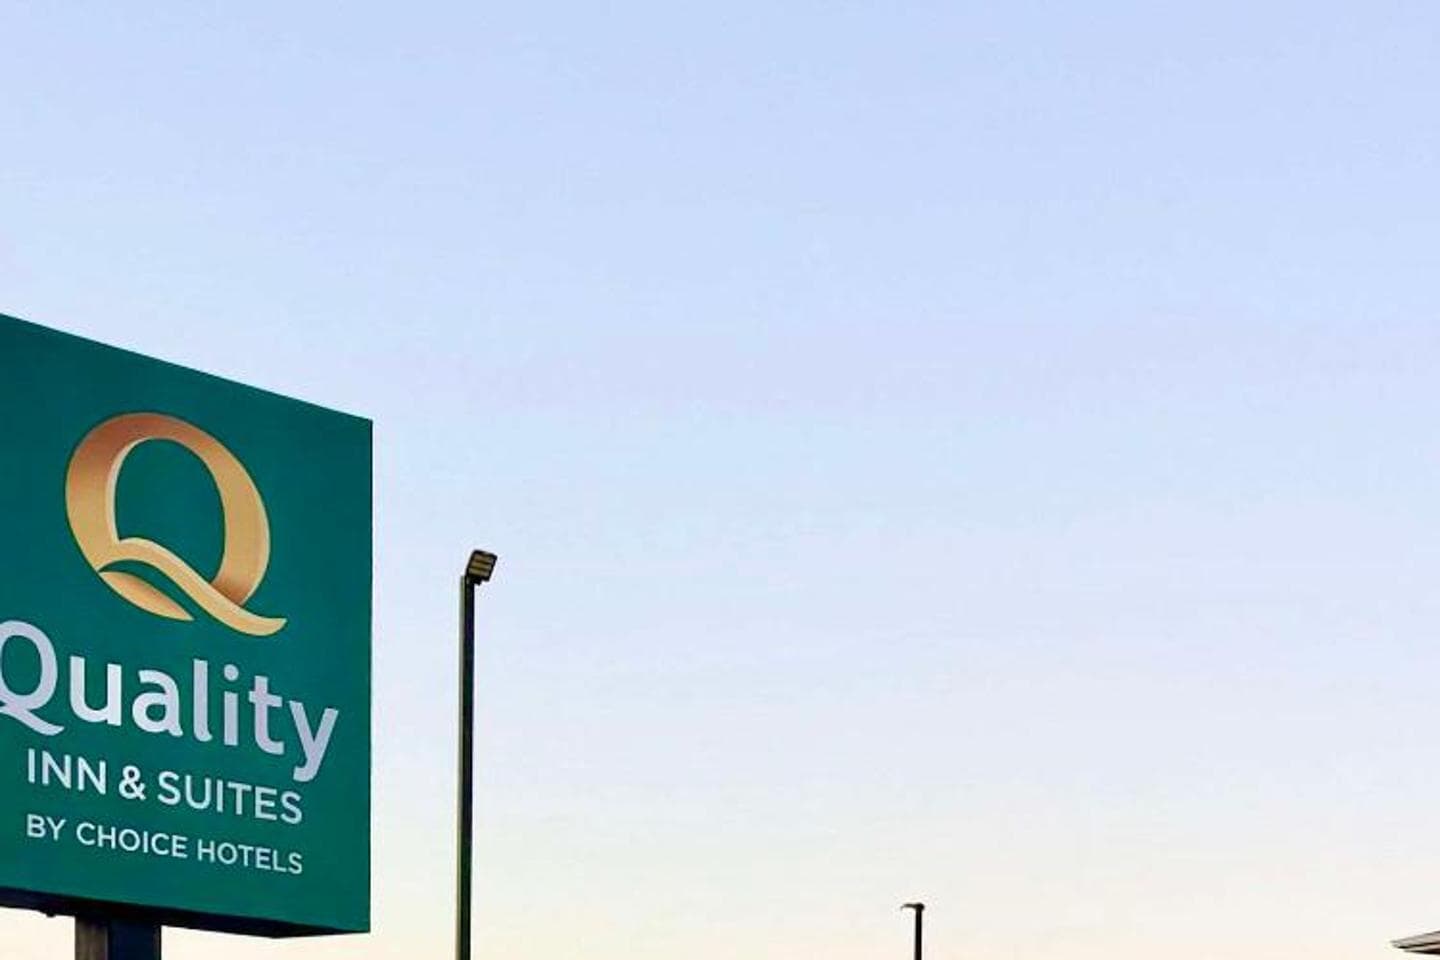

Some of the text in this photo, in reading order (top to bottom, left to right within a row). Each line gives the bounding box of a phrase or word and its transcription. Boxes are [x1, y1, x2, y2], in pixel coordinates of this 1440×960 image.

[65, 411, 287, 636] Q
[0, 620, 339, 782] Quality
[26, 814, 303, 874] BY CHOICE HOTELS
[27, 748, 303, 824] INN & SUITES
